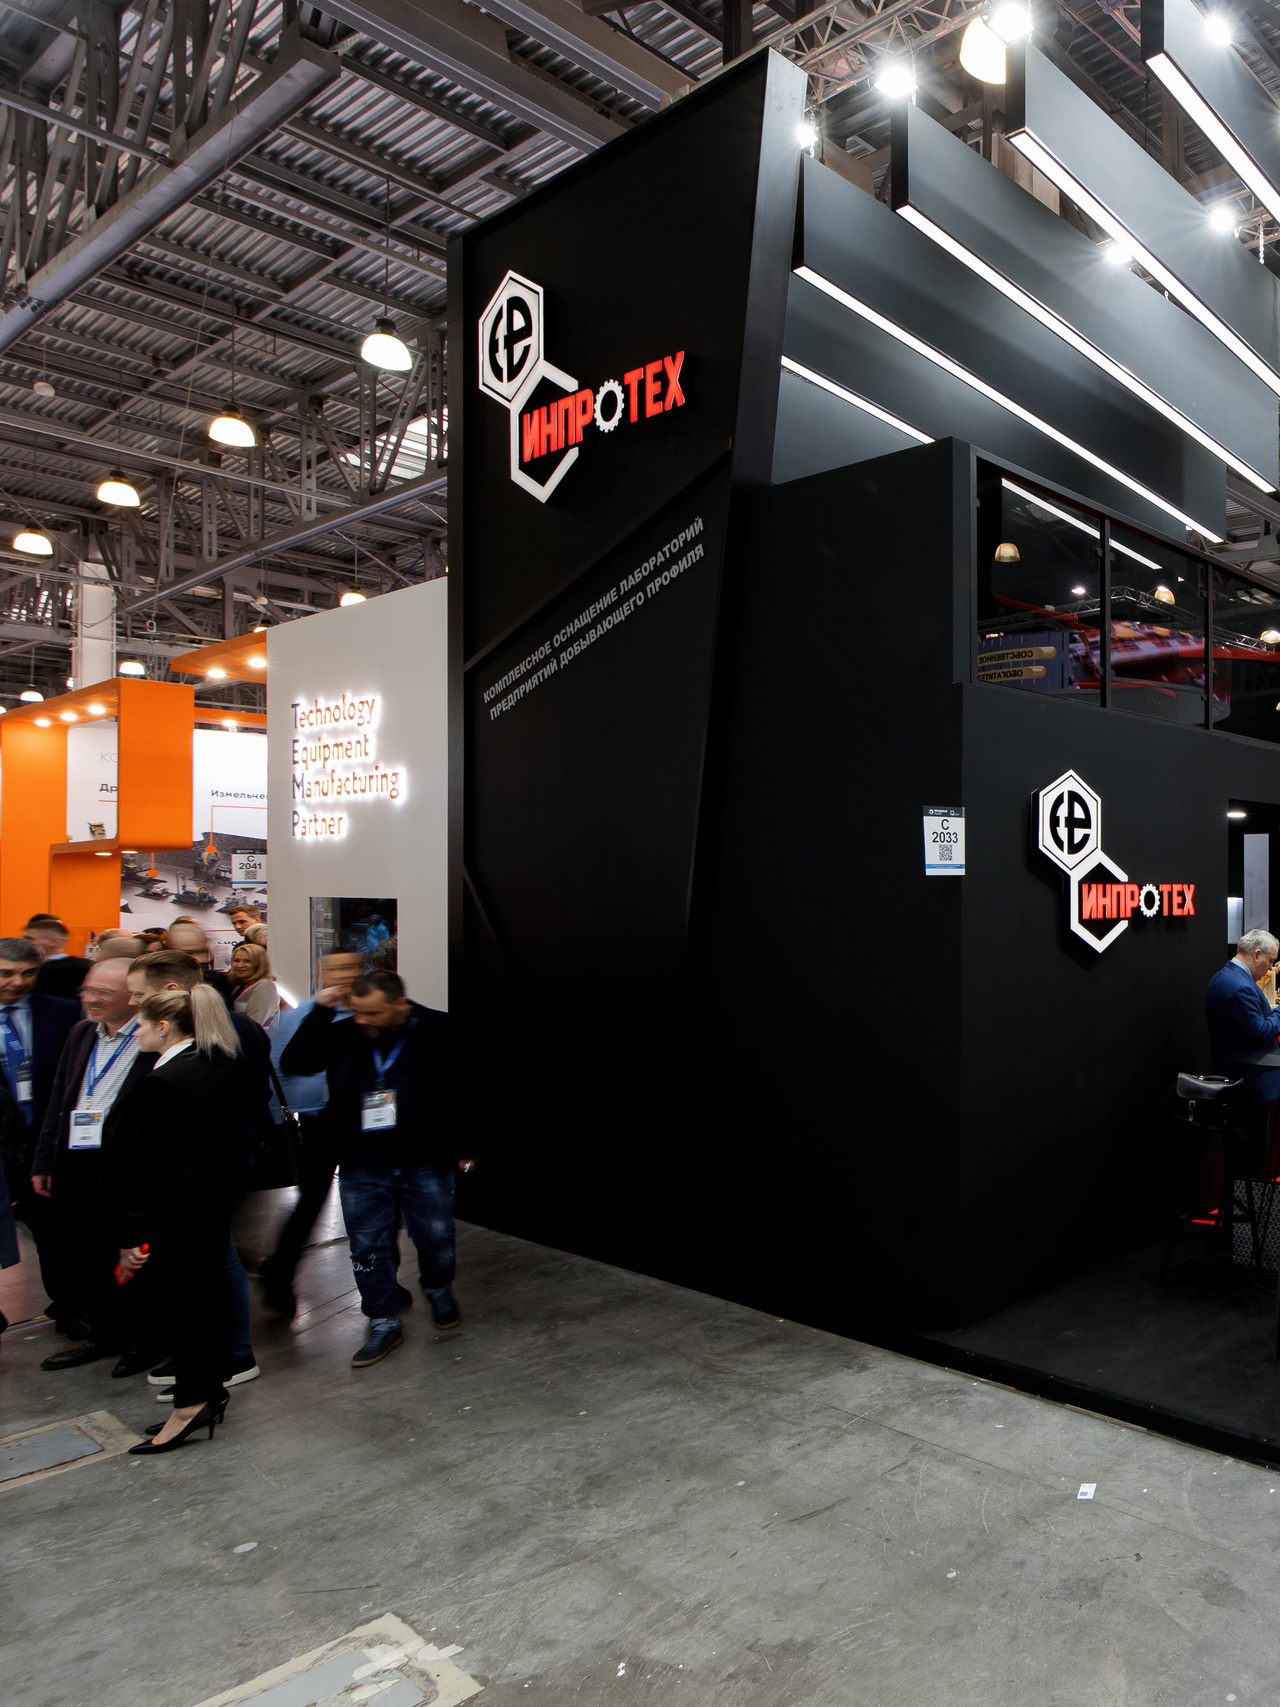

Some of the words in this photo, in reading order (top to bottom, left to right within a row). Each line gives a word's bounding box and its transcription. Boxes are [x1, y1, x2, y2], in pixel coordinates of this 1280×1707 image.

[522, 350, 685, 463] ИНПРОТЕХ
[483, 642, 552, 704] КОМПЛЕКСНОЕ
[553, 587, 618, 648] ОСНАЩЕНИЕ
[619, 516, 704, 595] ЛАБОРАТОРИЙ
[489, 656, 558, 721] ПРЕДПРИЯТИЙ
[559, 591, 645, 669] ДОБЫВАЮЩЕГО
[646, 543, 705, 598] ПРОФИЛЯ
[291, 694, 375, 729] Technology
[292, 734, 369, 770] Equipment
[211, 790, 267, 800] Измельче
[292, 765, 399, 799] Manufacturing
[292, 811, 343, 836] Partner
[932, 831, 958, 844] 2033
[1082, 883, 1195, 920] ИНПРОТЕХ
